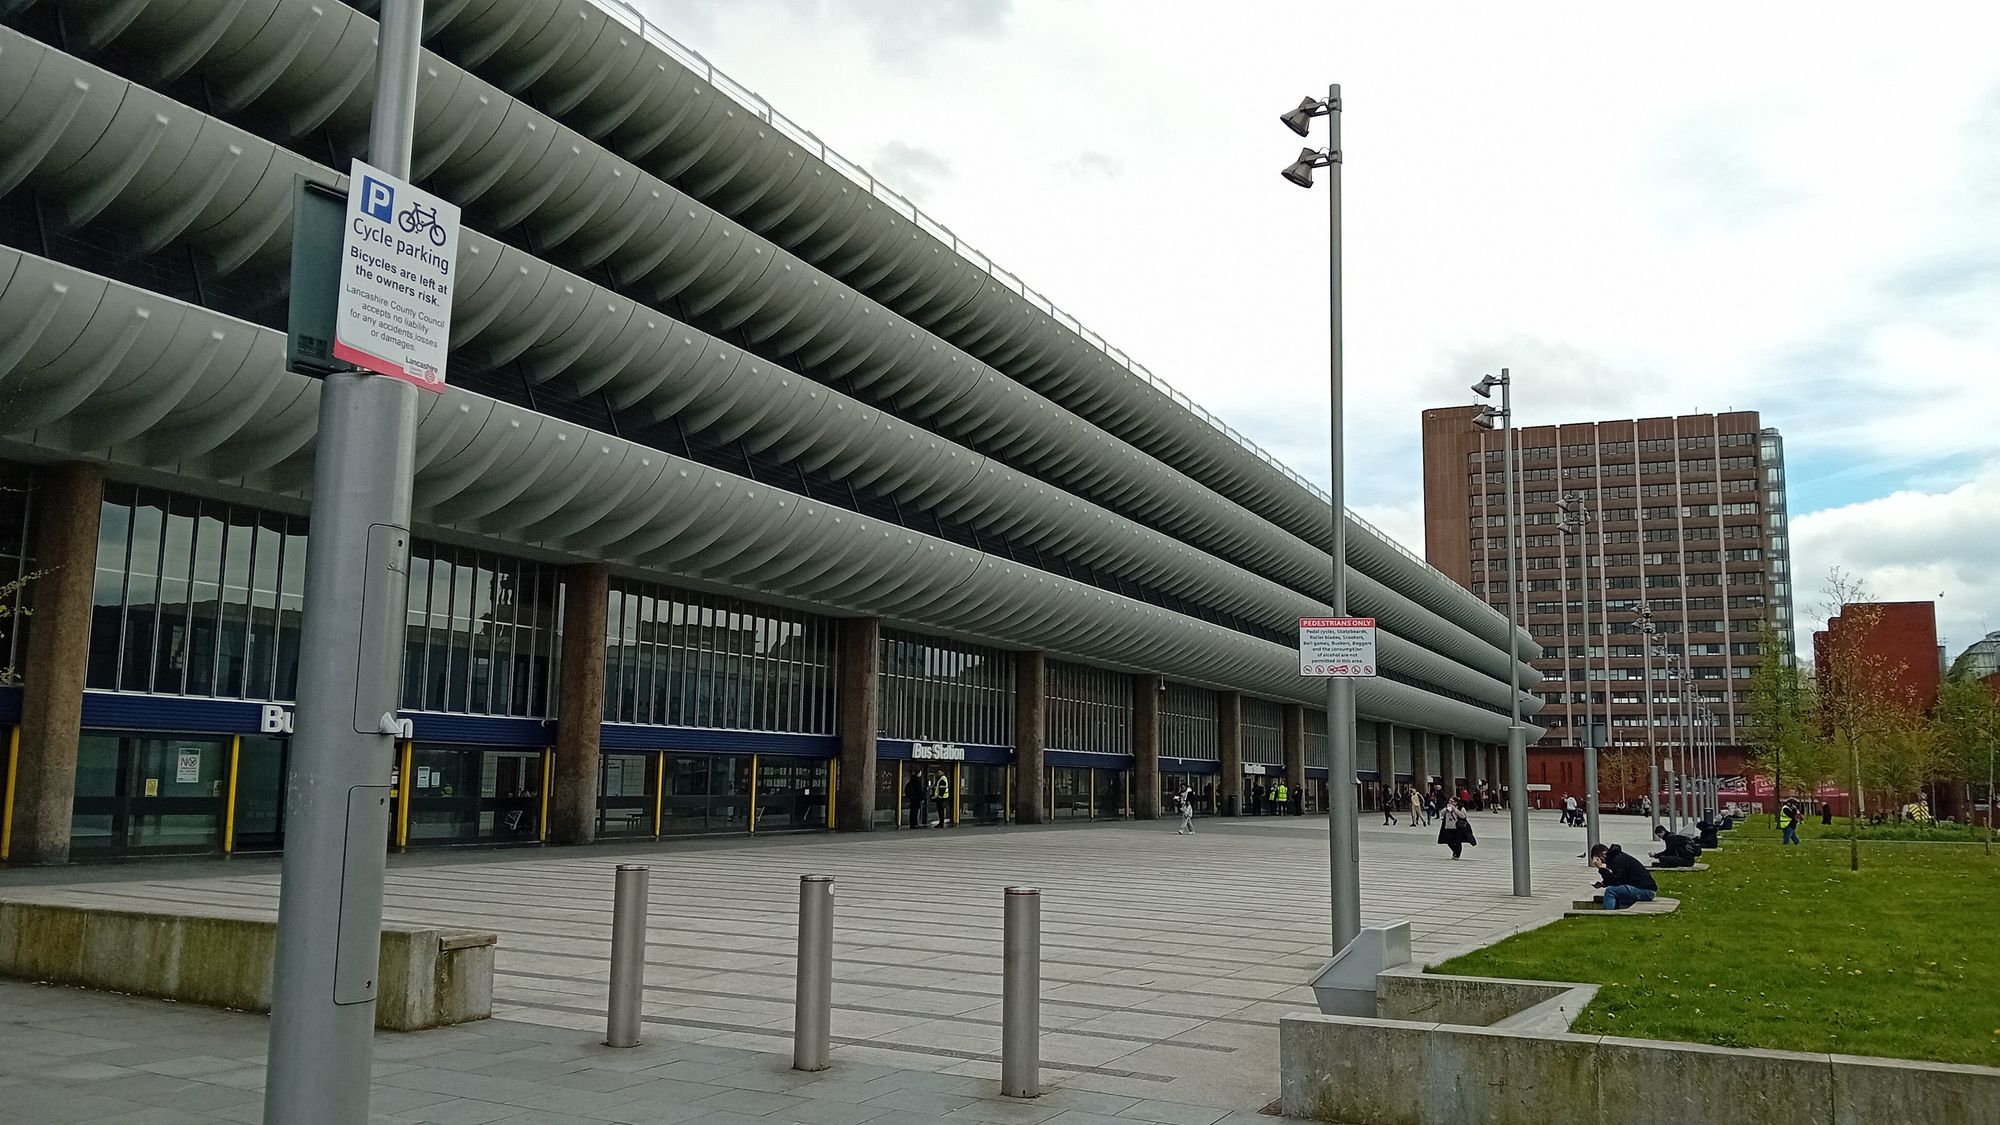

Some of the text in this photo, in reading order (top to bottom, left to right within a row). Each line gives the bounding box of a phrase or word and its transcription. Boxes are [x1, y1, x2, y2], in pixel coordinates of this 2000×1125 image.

[368, 182, 392, 216] P
[353, 218, 449, 275] Cycle parking
[350, 245, 448, 295] Bicycles are left at
[355, 264, 440, 307] the owners risk.
[346, 283, 445, 328] Lancashire County Council
[349, 308, 361, 320] for
[362, 314, 377, 327] any
[361, 302, 429, 334] accepts no liability
[370, 329, 416, 352] or damages.
[405, 356, 439, 374] Lancashire
[912, 743, 965, 761] Bus Station
